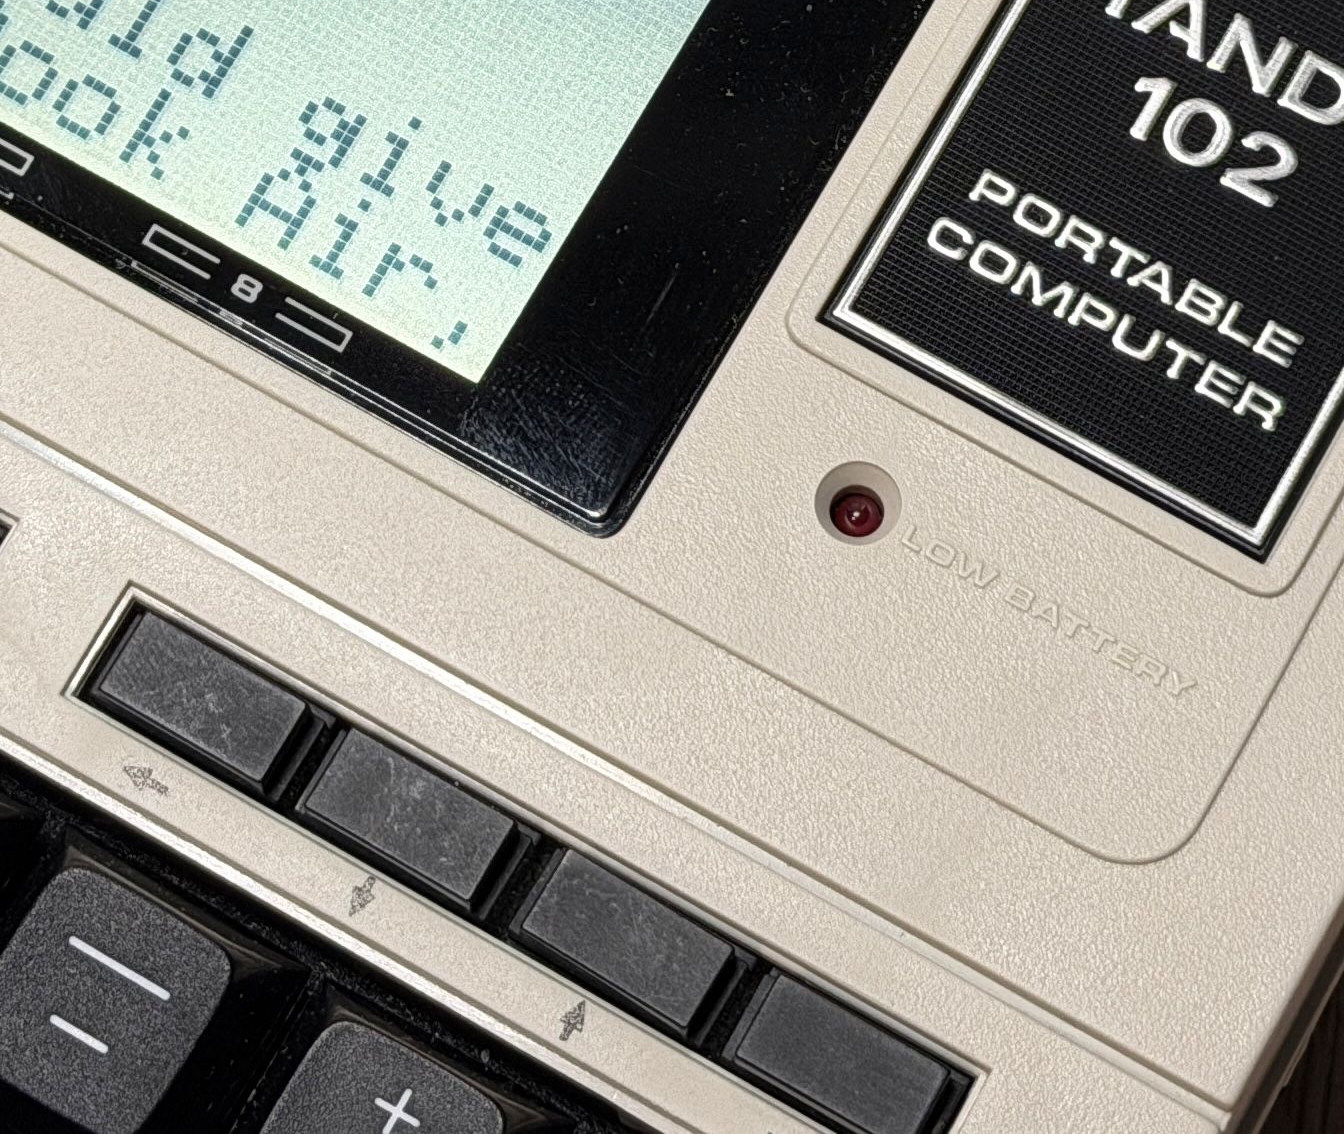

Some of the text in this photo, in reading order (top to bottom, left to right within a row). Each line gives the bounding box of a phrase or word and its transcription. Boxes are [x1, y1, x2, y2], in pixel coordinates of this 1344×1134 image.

[288, 95, 551, 269] give
[1129, 76, 1299, 209] 102
[231, 273, 264, 304] 8
[233, 159, 469, 350] Air,
[926, 217, 1289, 432] COMPUTER
[968, 168, 1306, 368] PORTABLE
[901, 524, 1199, 698] LOW BATTERY
